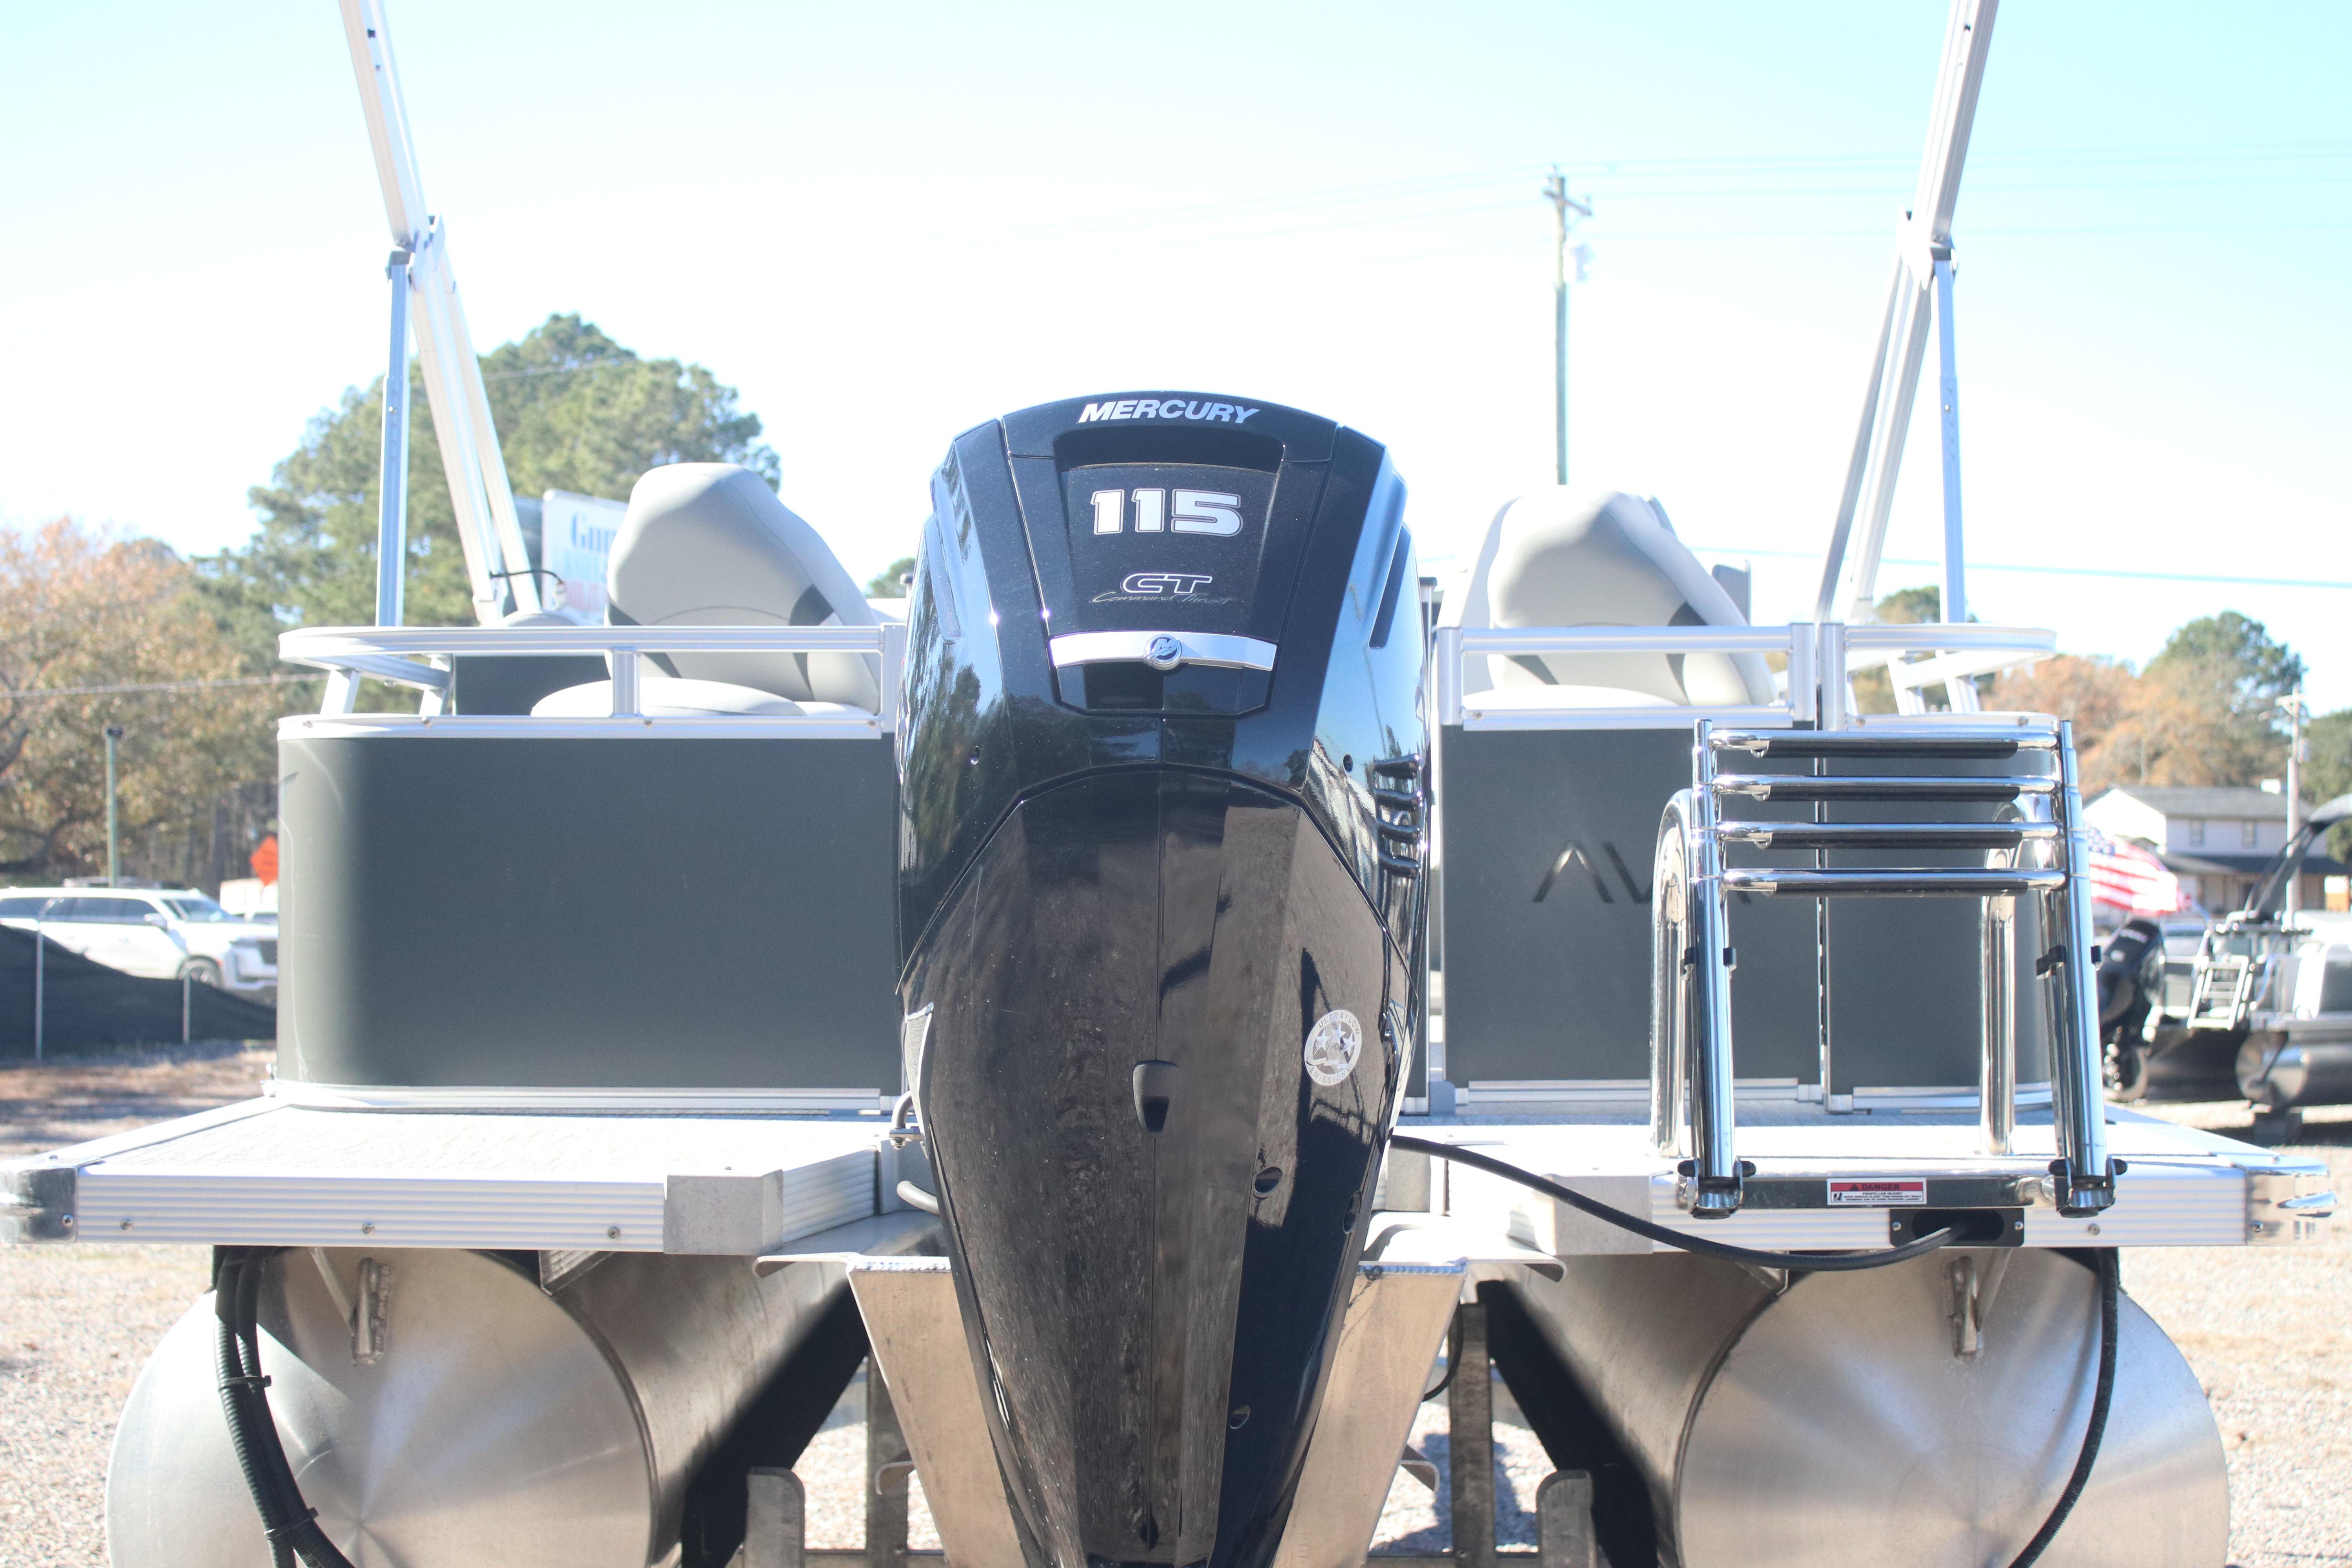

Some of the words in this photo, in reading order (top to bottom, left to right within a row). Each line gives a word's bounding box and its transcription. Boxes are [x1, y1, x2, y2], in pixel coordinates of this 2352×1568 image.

[1076, 399, 1260, 424] MERCURY
[1090, 488, 1243, 537] 115
[1090, 591, 1176, 603] Command
[1178, 593, 1232, 604] Thrust
[1348, 1017, 1360, 1035] LOW
[1309, 1067, 1346, 1084] EMISSION
